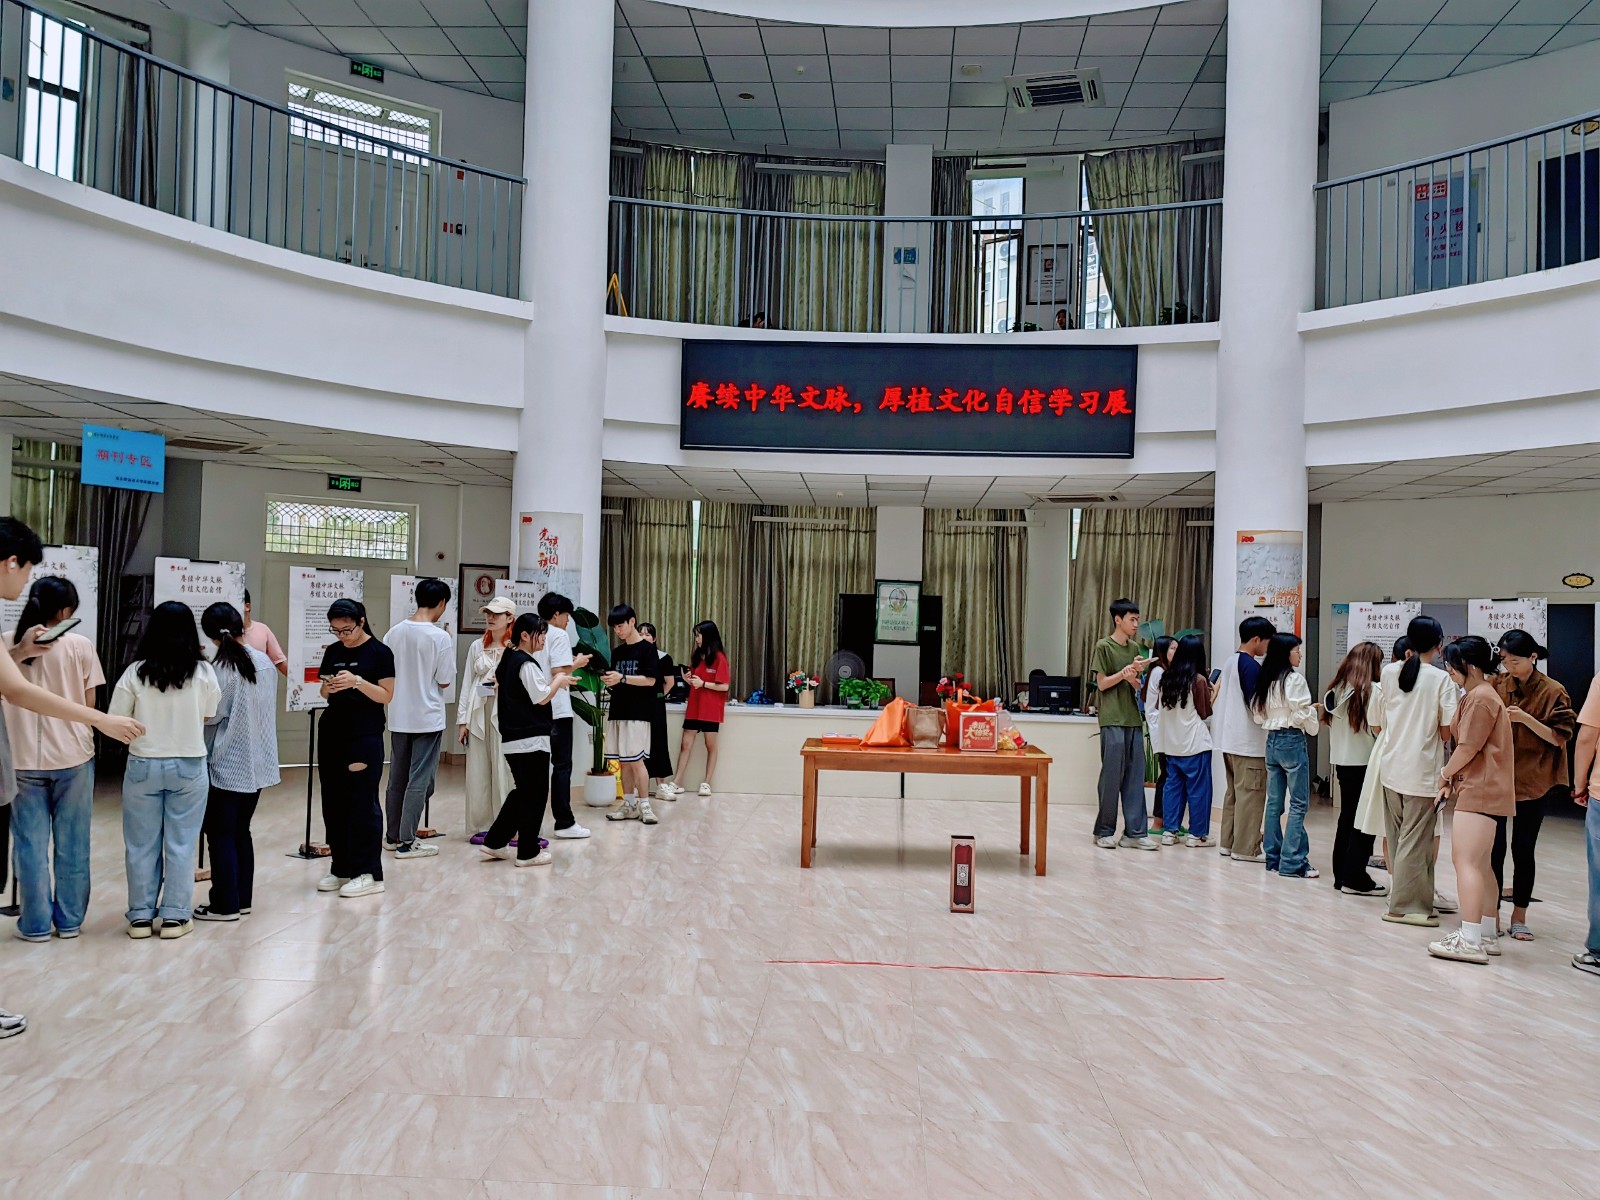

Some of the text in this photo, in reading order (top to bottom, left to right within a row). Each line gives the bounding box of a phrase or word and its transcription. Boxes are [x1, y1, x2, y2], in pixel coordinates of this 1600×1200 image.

[686, 381, 1132, 416] 赓续中华文脉，厚植文化自信学习展
[97, 449, 152, 468] 期刊专区
